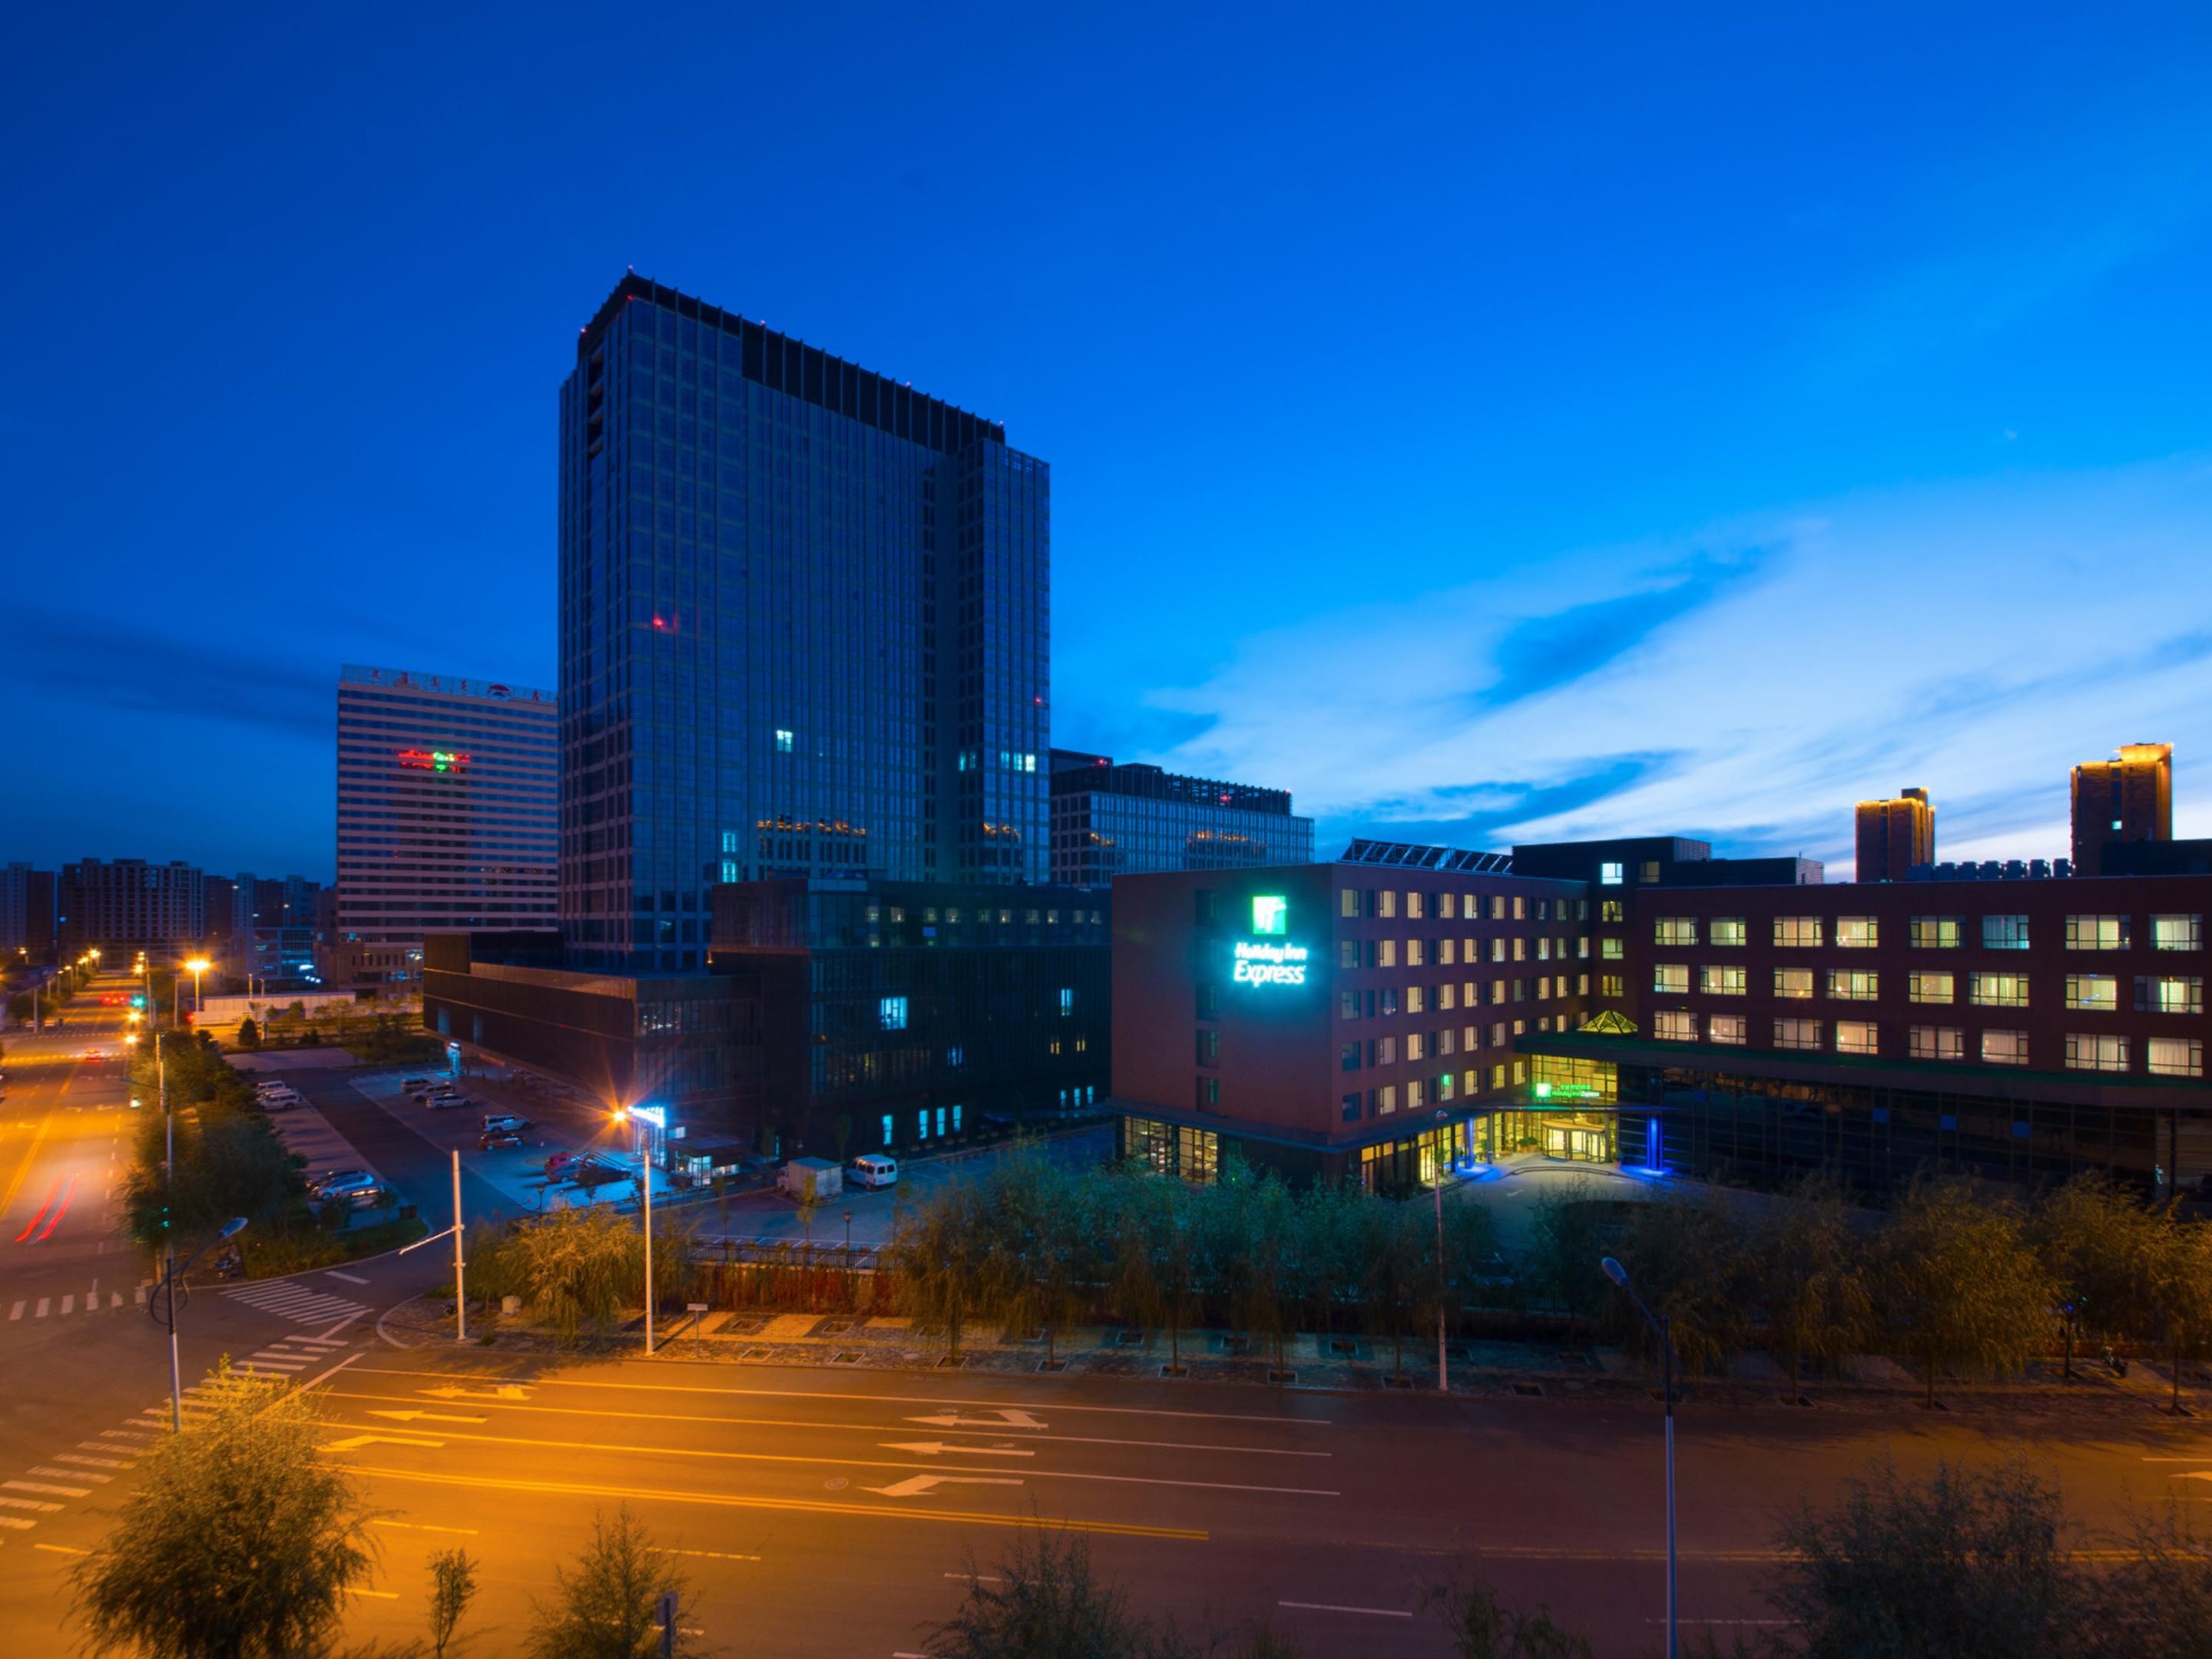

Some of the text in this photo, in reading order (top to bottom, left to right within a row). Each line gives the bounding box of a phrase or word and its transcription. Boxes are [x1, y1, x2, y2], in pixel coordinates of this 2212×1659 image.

[1235, 942, 1307, 963] Holiday Inn
[1233, 959, 1306, 987] Express
